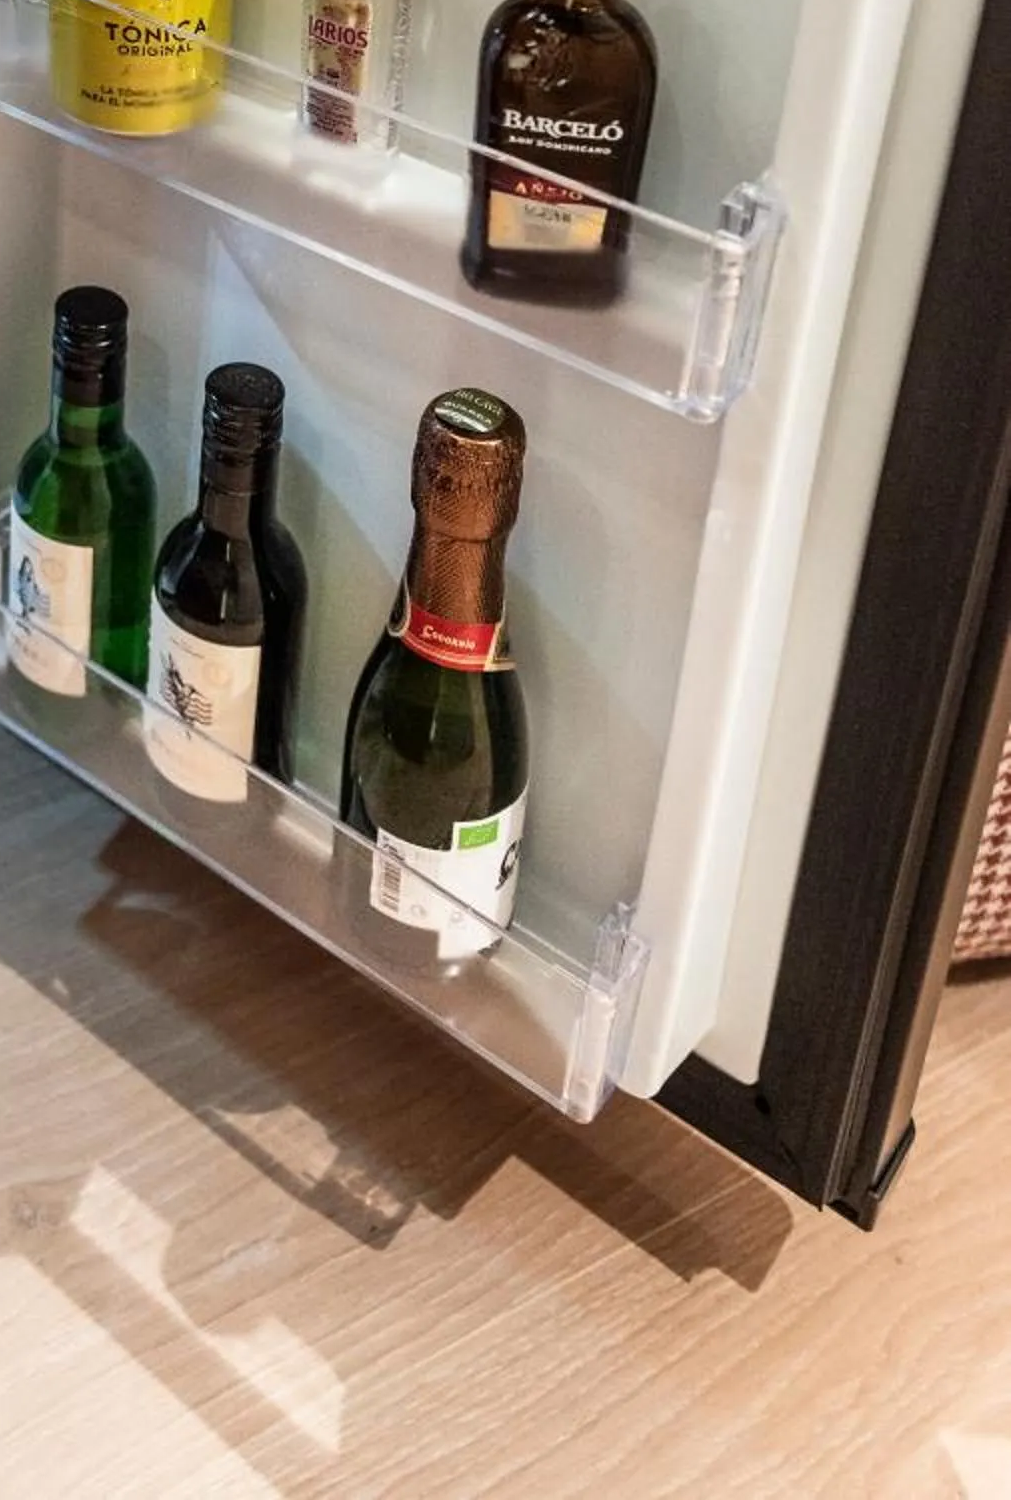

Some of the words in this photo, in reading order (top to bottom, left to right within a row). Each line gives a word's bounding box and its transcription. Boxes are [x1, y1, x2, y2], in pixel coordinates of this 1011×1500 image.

[104, 17, 206, 45] TÓNICA
[309, 15, 369, 48] LARIOS
[117, 43, 193, 57] ORIGINAL
[502, 108, 624, 141] BARCELÓ
